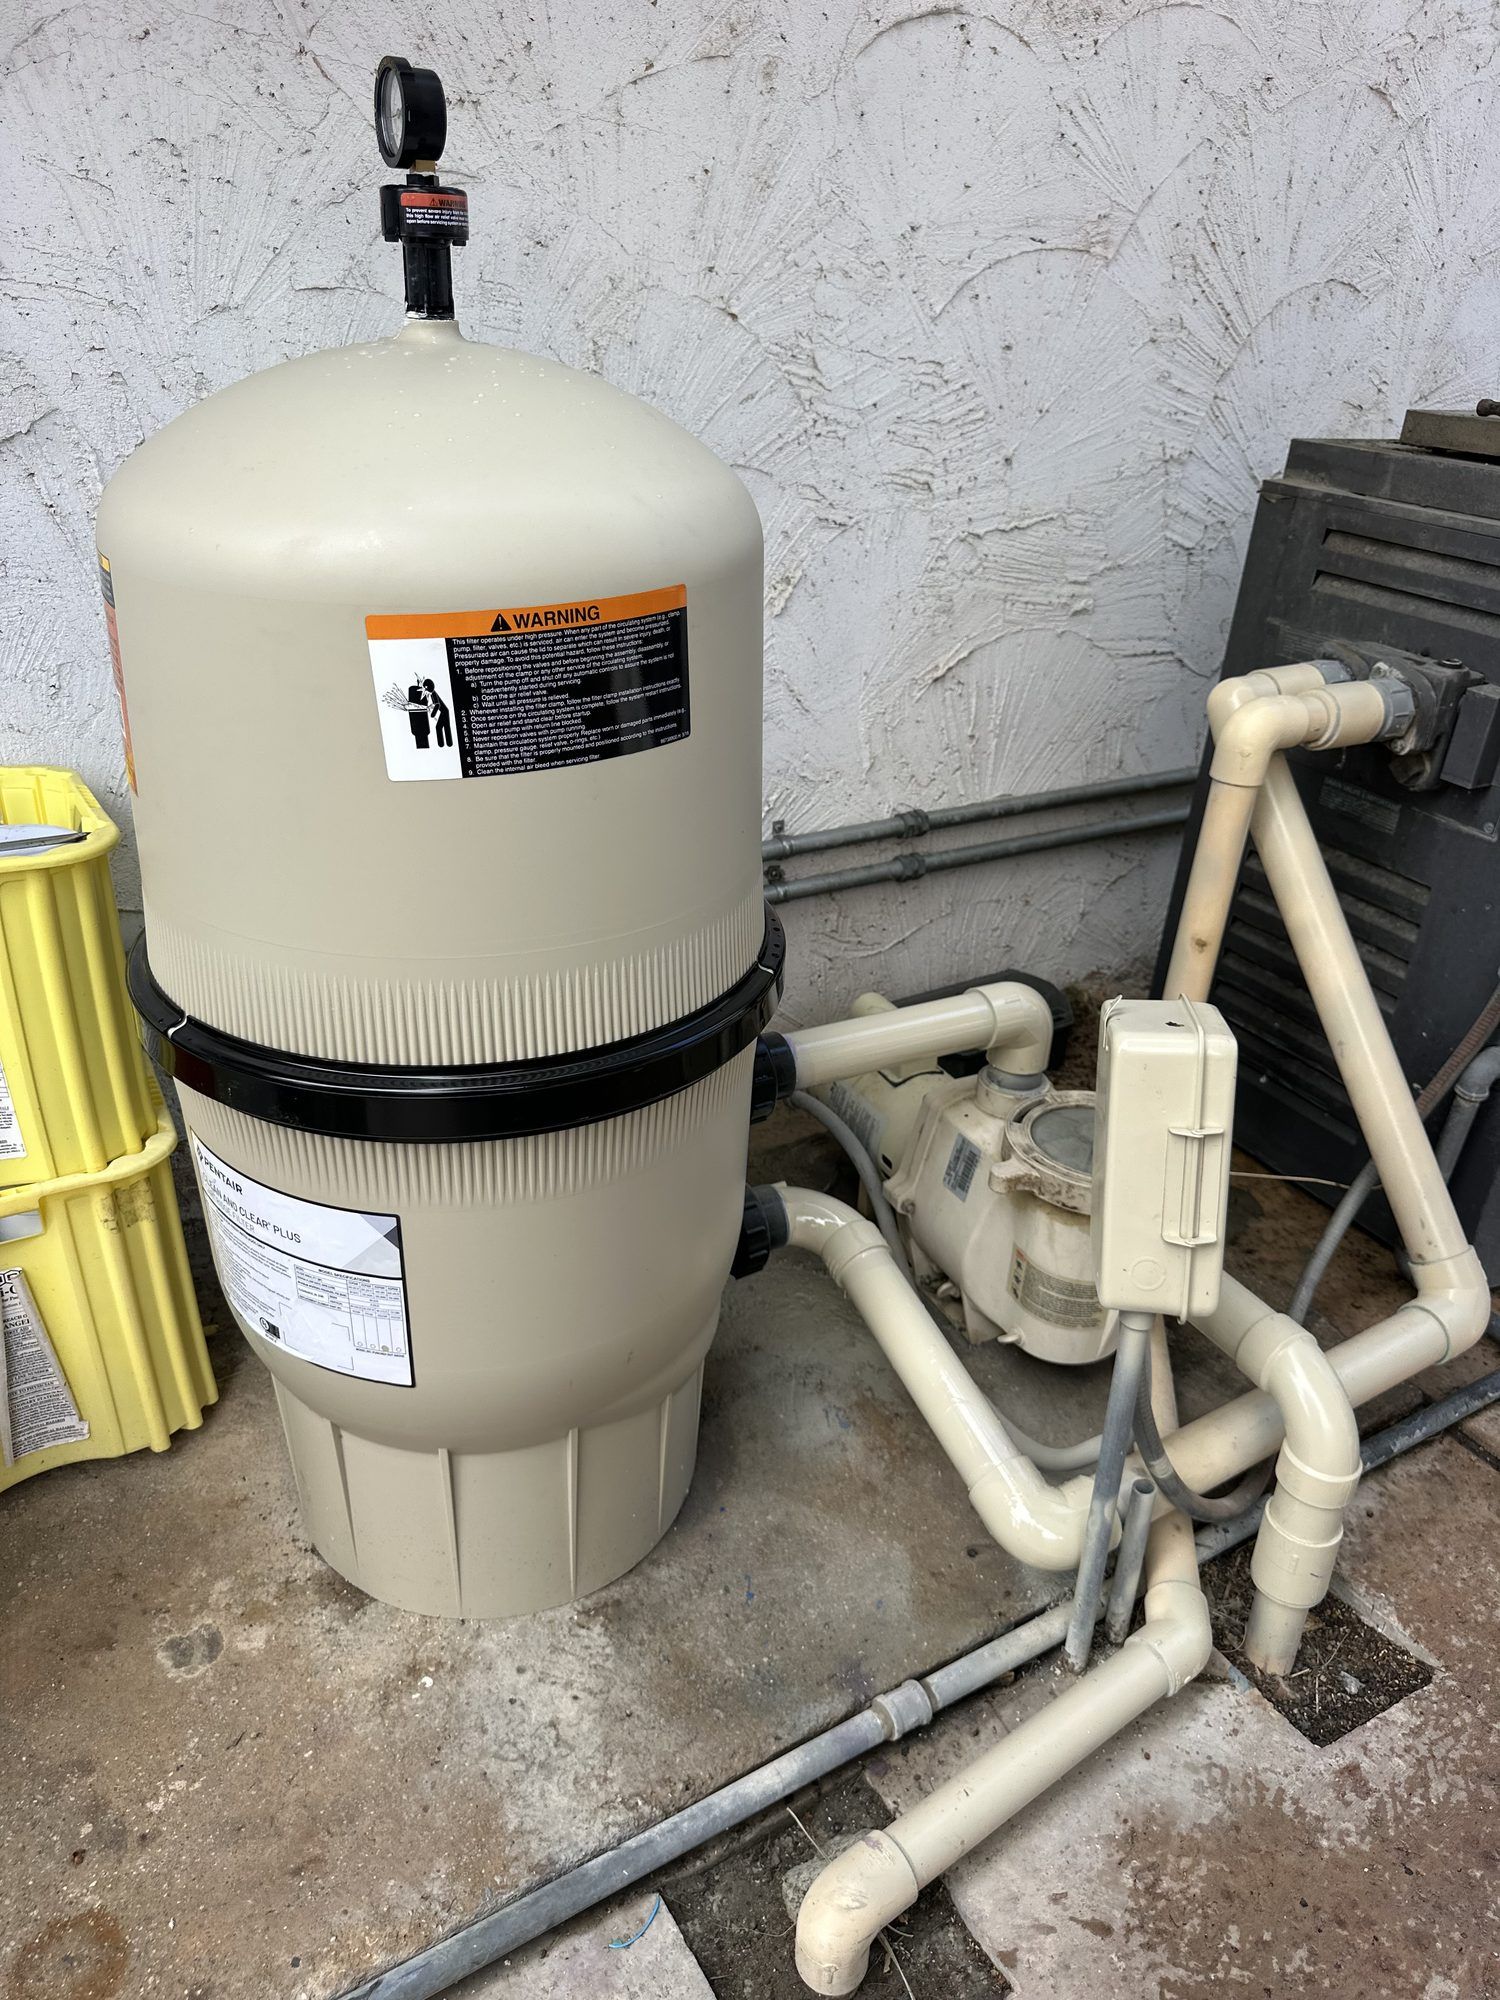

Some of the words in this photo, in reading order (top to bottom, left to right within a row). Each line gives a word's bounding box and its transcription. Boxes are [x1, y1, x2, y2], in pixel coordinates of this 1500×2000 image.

[512, 606, 600, 628] WARNING
[480, 636, 505, 644] operates
[553, 642, 576, 651] separate
[454, 659, 479, 668] property
[541, 650, 564, 660] potential
[517, 696, 541, 705] pressure
[556, 705, 575, 714] system
[550, 727, 565, 735] pump
[538, 734, 558, 743] system
[494, 746, 518, 755] pressure
[540, 747, 561, 756] properly
[476, 760, 500, 769] provided
[204, 1157, 242, 1195] PENTAIR
[223, 1194, 238, 1212] AND
[273, 1224, 302, 1244] PLUS
